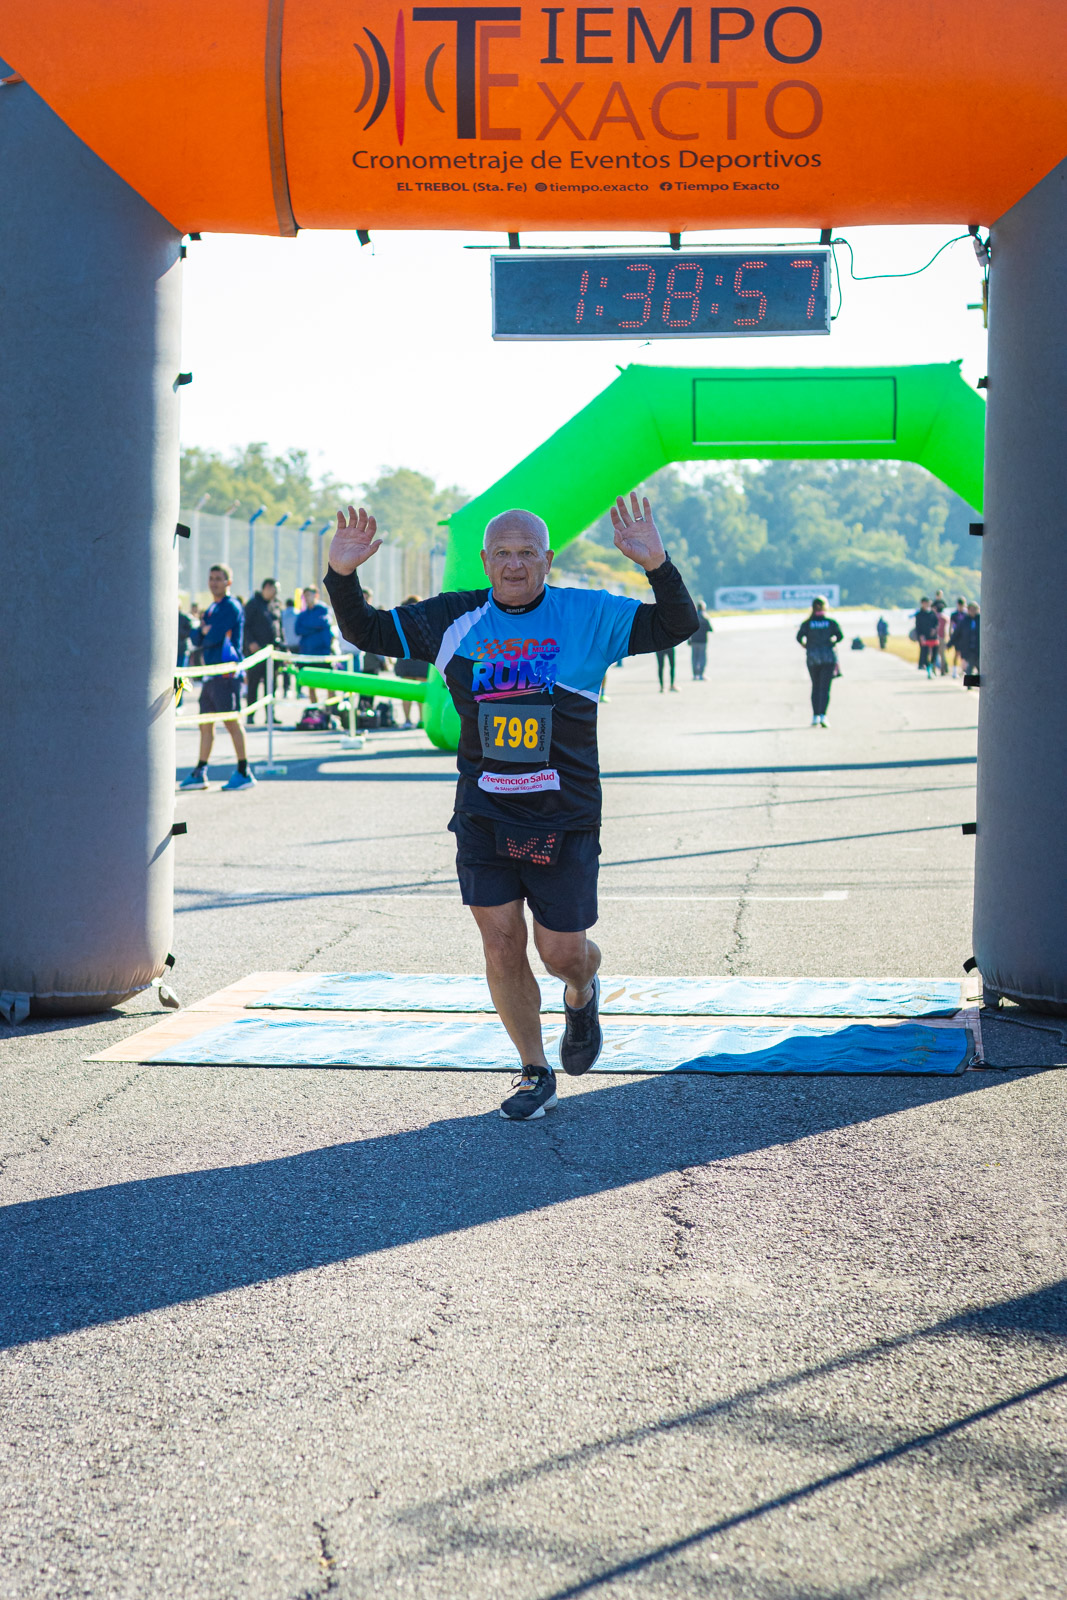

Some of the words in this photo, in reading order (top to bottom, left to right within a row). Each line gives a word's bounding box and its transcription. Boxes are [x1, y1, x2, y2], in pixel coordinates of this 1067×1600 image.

[352, 150, 523, 173] Cronometraje
[531, 150, 562, 169] de
[570, 151, 671, 169] Eventos
[678, 150, 822, 172] Deportivos
[397, 182, 413, 192] EL
[415, 182, 470, 192] TREBOL
[473, 182, 503, 193] (Sta.
[507, 182, 528, 193] Fe)
[550, 182, 649, 194] tiempo.exacto
[674, 181, 729, 192] Tiempo
[732, 181, 780, 192] Exacto
[575, 260, 819, 328] 1:38:57
[493, 716, 539, 749] 798
[482, 774, 529, 785] Prevención
[530, 772, 555, 783] Salud
